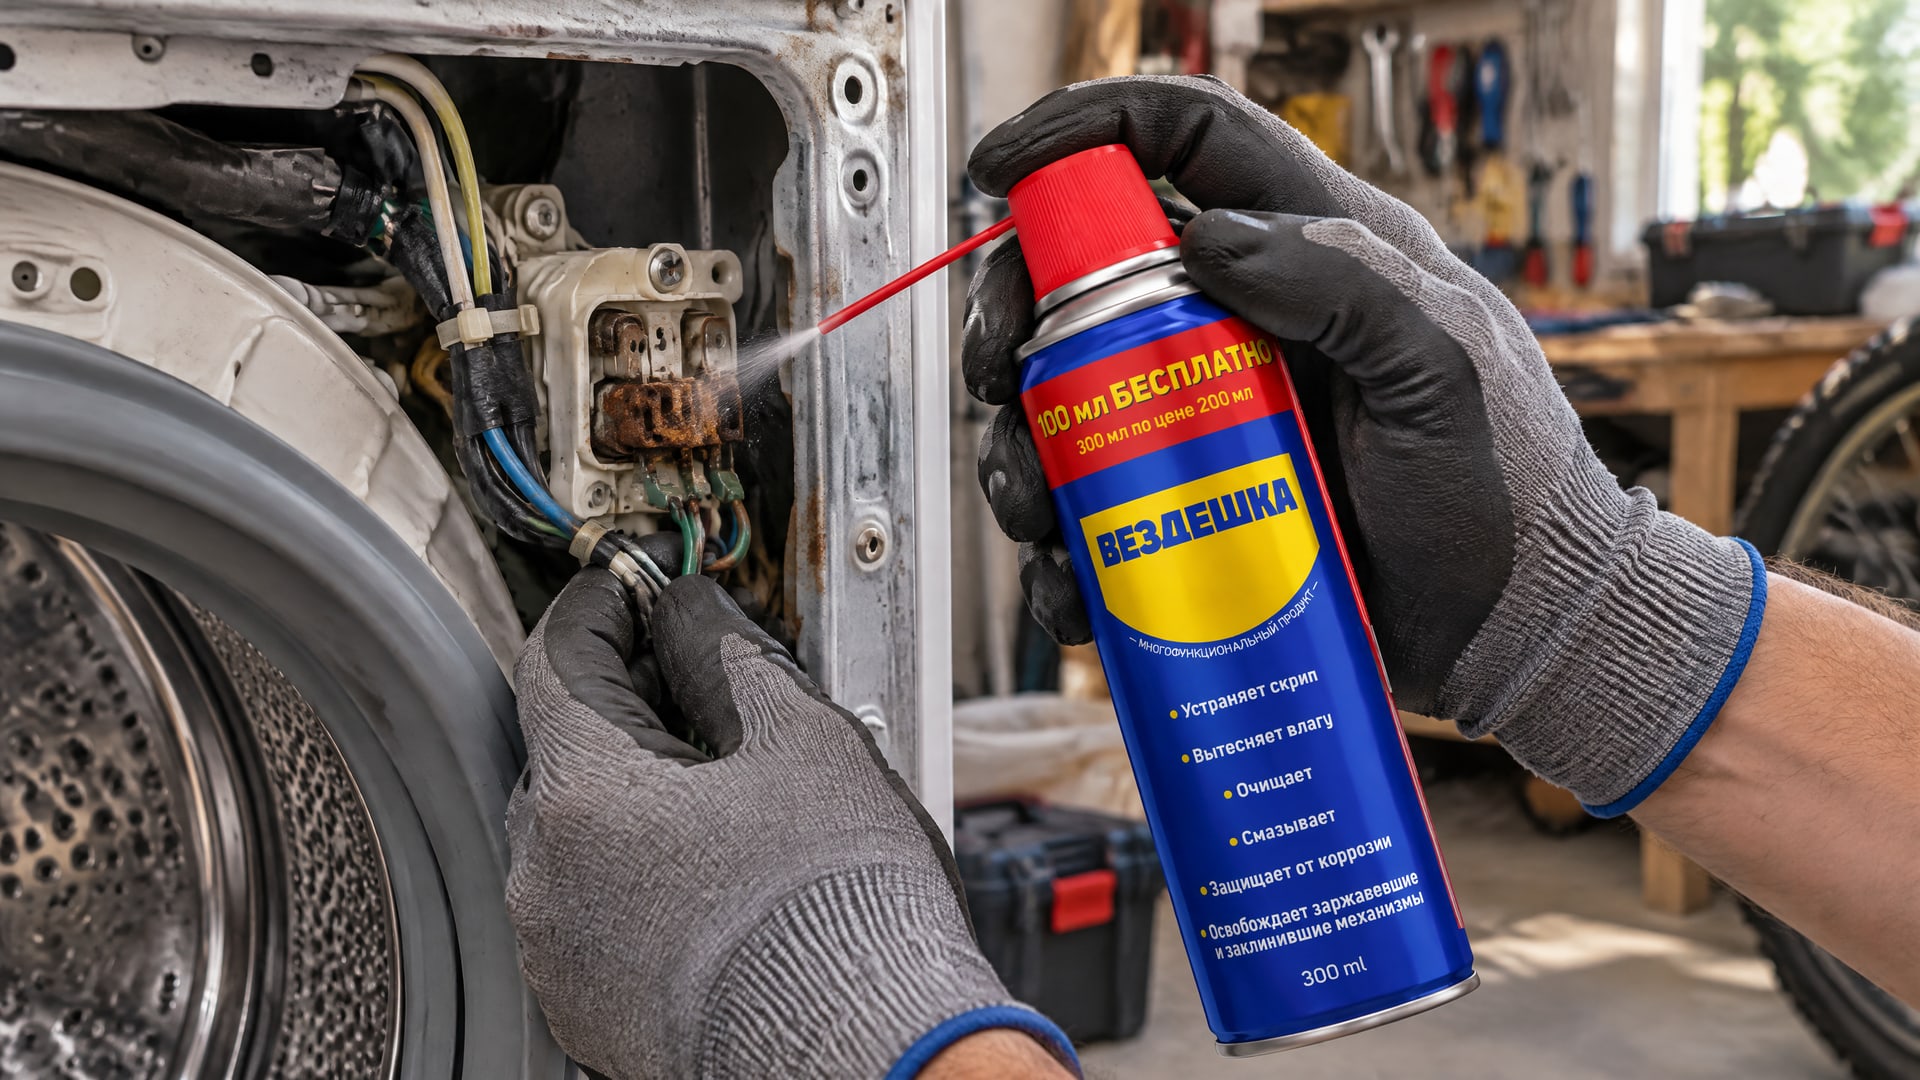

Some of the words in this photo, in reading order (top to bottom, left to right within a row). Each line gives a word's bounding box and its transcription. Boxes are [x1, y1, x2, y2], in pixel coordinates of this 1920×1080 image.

[1037, 404, 1071, 438] 100
[1073, 395, 1110, 424] мл
[1109, 338, 1274, 410] БЕСПЛАТНО
[1076, 432, 1104, 455] 300
[1107, 427, 1129, 443] мл
[1131, 419, 1152, 436] по
[1155, 406, 1195, 429] цене
[1196, 390, 1230, 414] 200
[1232, 386, 1254, 403] мл
[1096, 477, 1298, 568] ВЕЗДЕШКА
[1138, 622, 1279, 659] МНОГОФУНКЦИОНАЛЬНЫЙ
[1278, 588, 1315, 628] ПРОДУКТ
[1180, 684, 1266, 719] Устраняет
[1269, 669, 1319, 694] скрип
[1192, 727, 1283, 764] Вытесняет
[1286, 713, 1334, 738] влагу
[1236, 767, 1313, 798] Очищает
[1241, 808, 1336, 846] Смазывает
[1208, 866, 1291, 897] Защищает
[1296, 860, 1314, 876] от
[1318, 835, 1393, 869] коррозии
[1208, 906, 1308, 940] Освобождает
[1311, 871, 1419, 917] заржавевшие
[1215, 946, 1224, 960] и
[1225, 920, 1333, 959] заклинившие
[1335, 891, 1425, 931] механизмы
[1300, 963, 1340, 987] 300
[1342, 956, 1368, 976] ml
